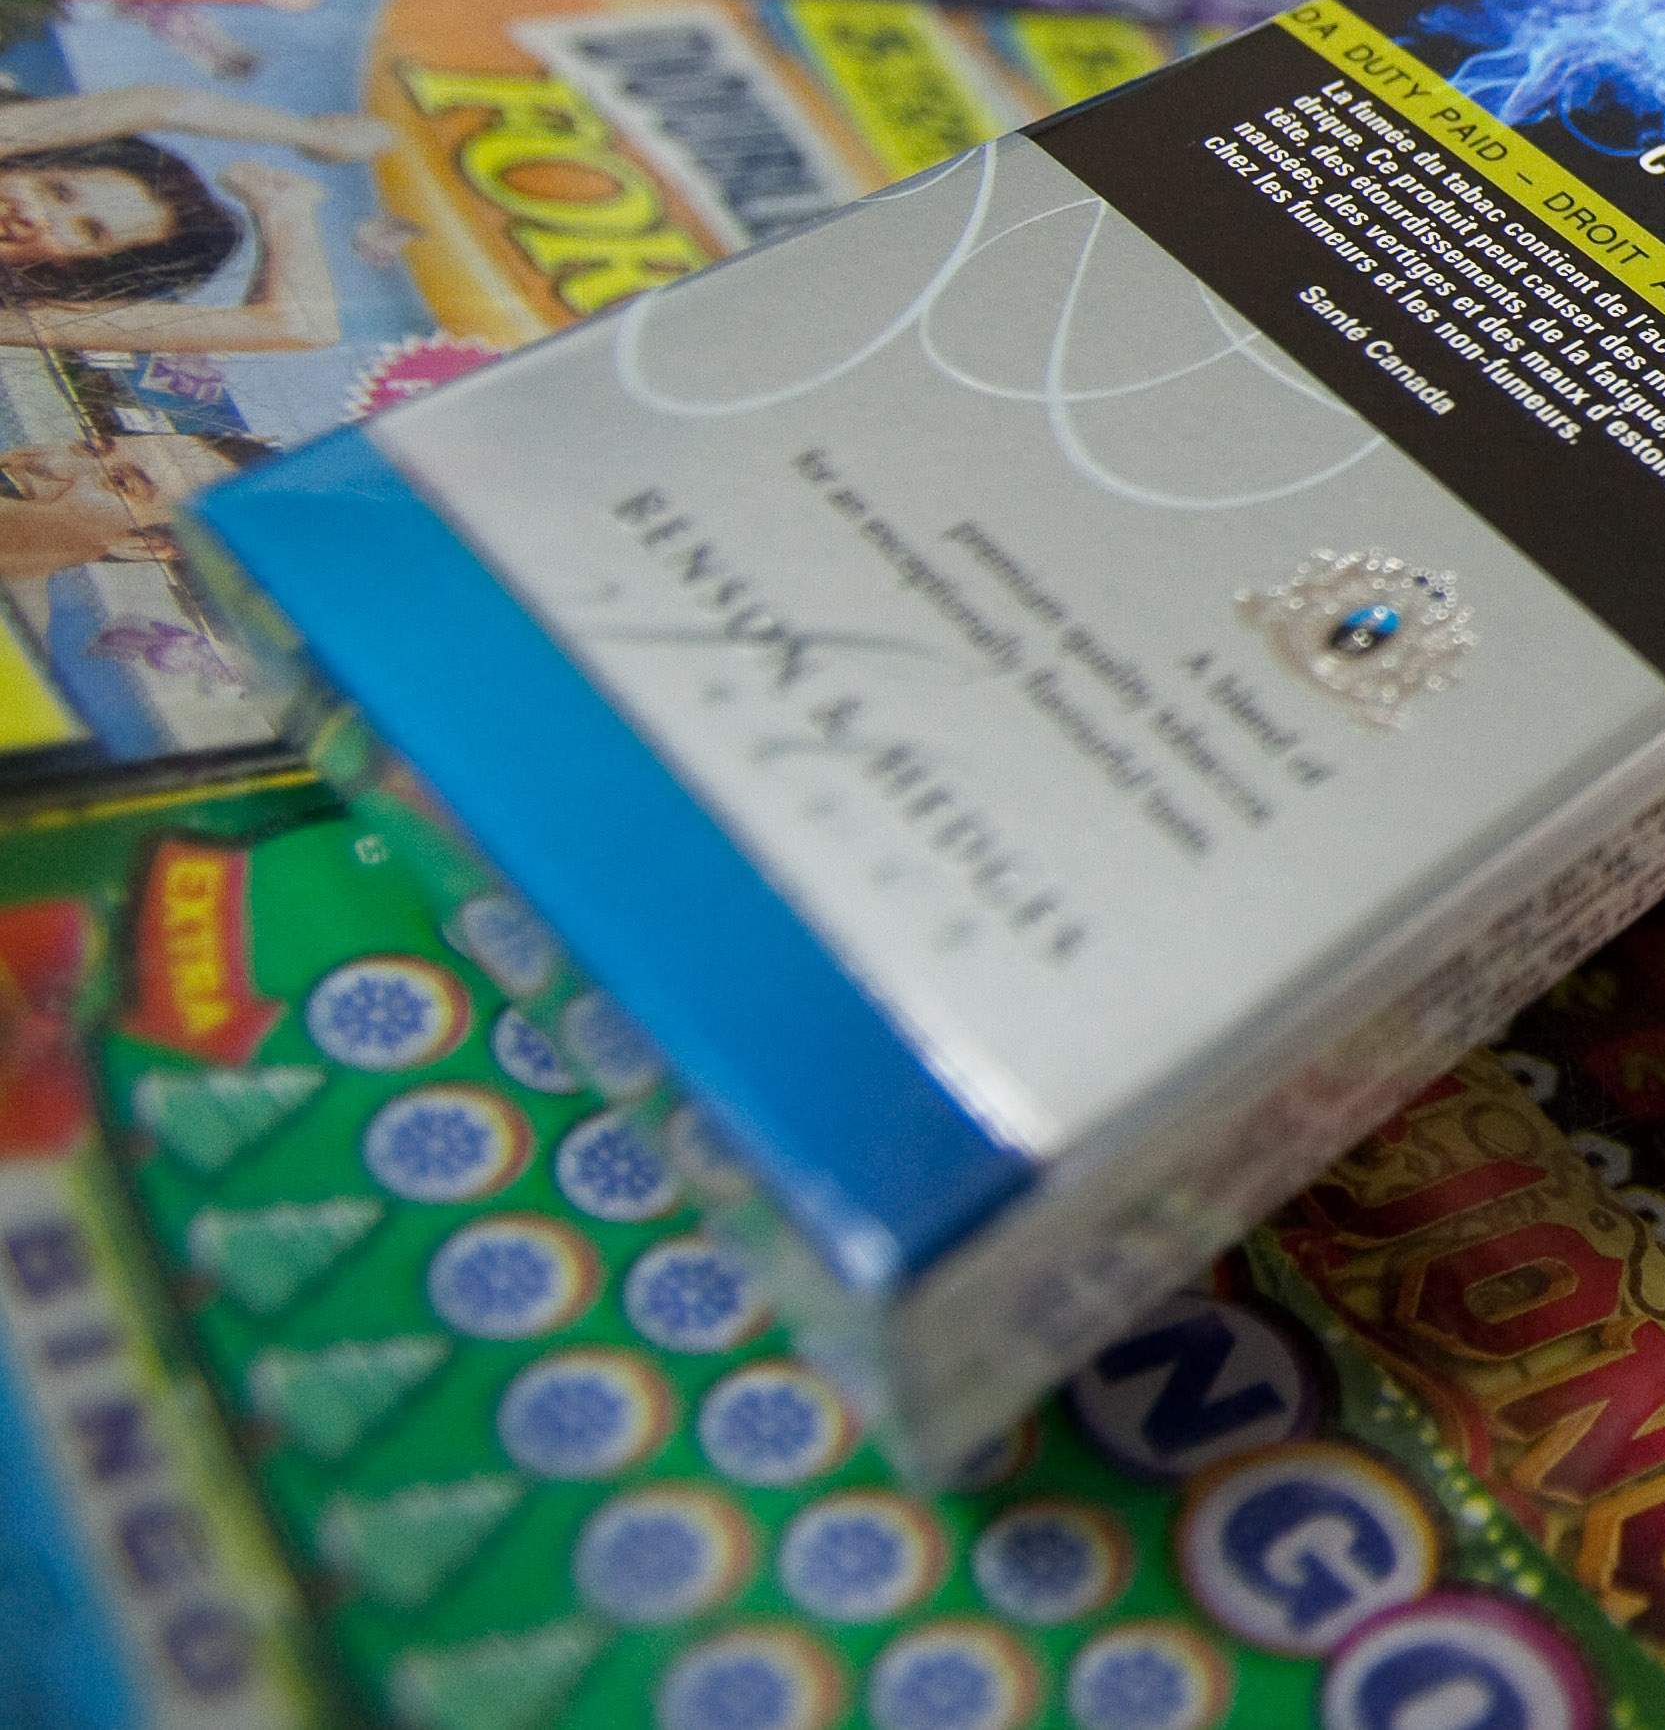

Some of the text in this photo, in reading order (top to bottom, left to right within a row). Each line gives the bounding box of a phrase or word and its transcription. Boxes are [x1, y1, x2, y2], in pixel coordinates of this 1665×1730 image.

[1234, 122, 1323, 195] nausées,
[1325, 194, 1369, 225] des
[1366, 225, 1456, 296] vertiges
[1453, 297, 1485, 318] et
[1478, 317, 1525, 351] des
[1521, 351, 1590, 405] maux
[1265, 108, 1309, 146] tête,
[1311, 146, 1354, 176] des
[1351, 176, 1526, 319] étourdissements,
[1528, 318, 1563, 342] de
[1560, 340, 1590, 365] la
[1294, 96, 1362, 151] drique.
[1366, 149, 1398, 174] Ce
[1388, 174, 1478, 235] produit
[1465, 234, 1528, 275] peut
[1523, 274, 1604, 333] causer
[1600, 335, 1646, 370] des
[1322, 80, 1352, 105] La
[1349, 101, 1416, 154] fumée
[1413, 152, 1446, 175] du
[1443, 173, 1506, 222] tabac
[1504, 223, 1599, 294] contient
[1594, 293, 1627, 317] de
[1343, 43, 1431, 99] DUTY
[1430, 108, 1508, 162] PAID
[1543, 191, 1650, 265] DROIT
[1205, 137, 1581, 444] chez les fumeurs et les non-fumeurs.
[1300, 286, 1454, 414] Santé Canada
